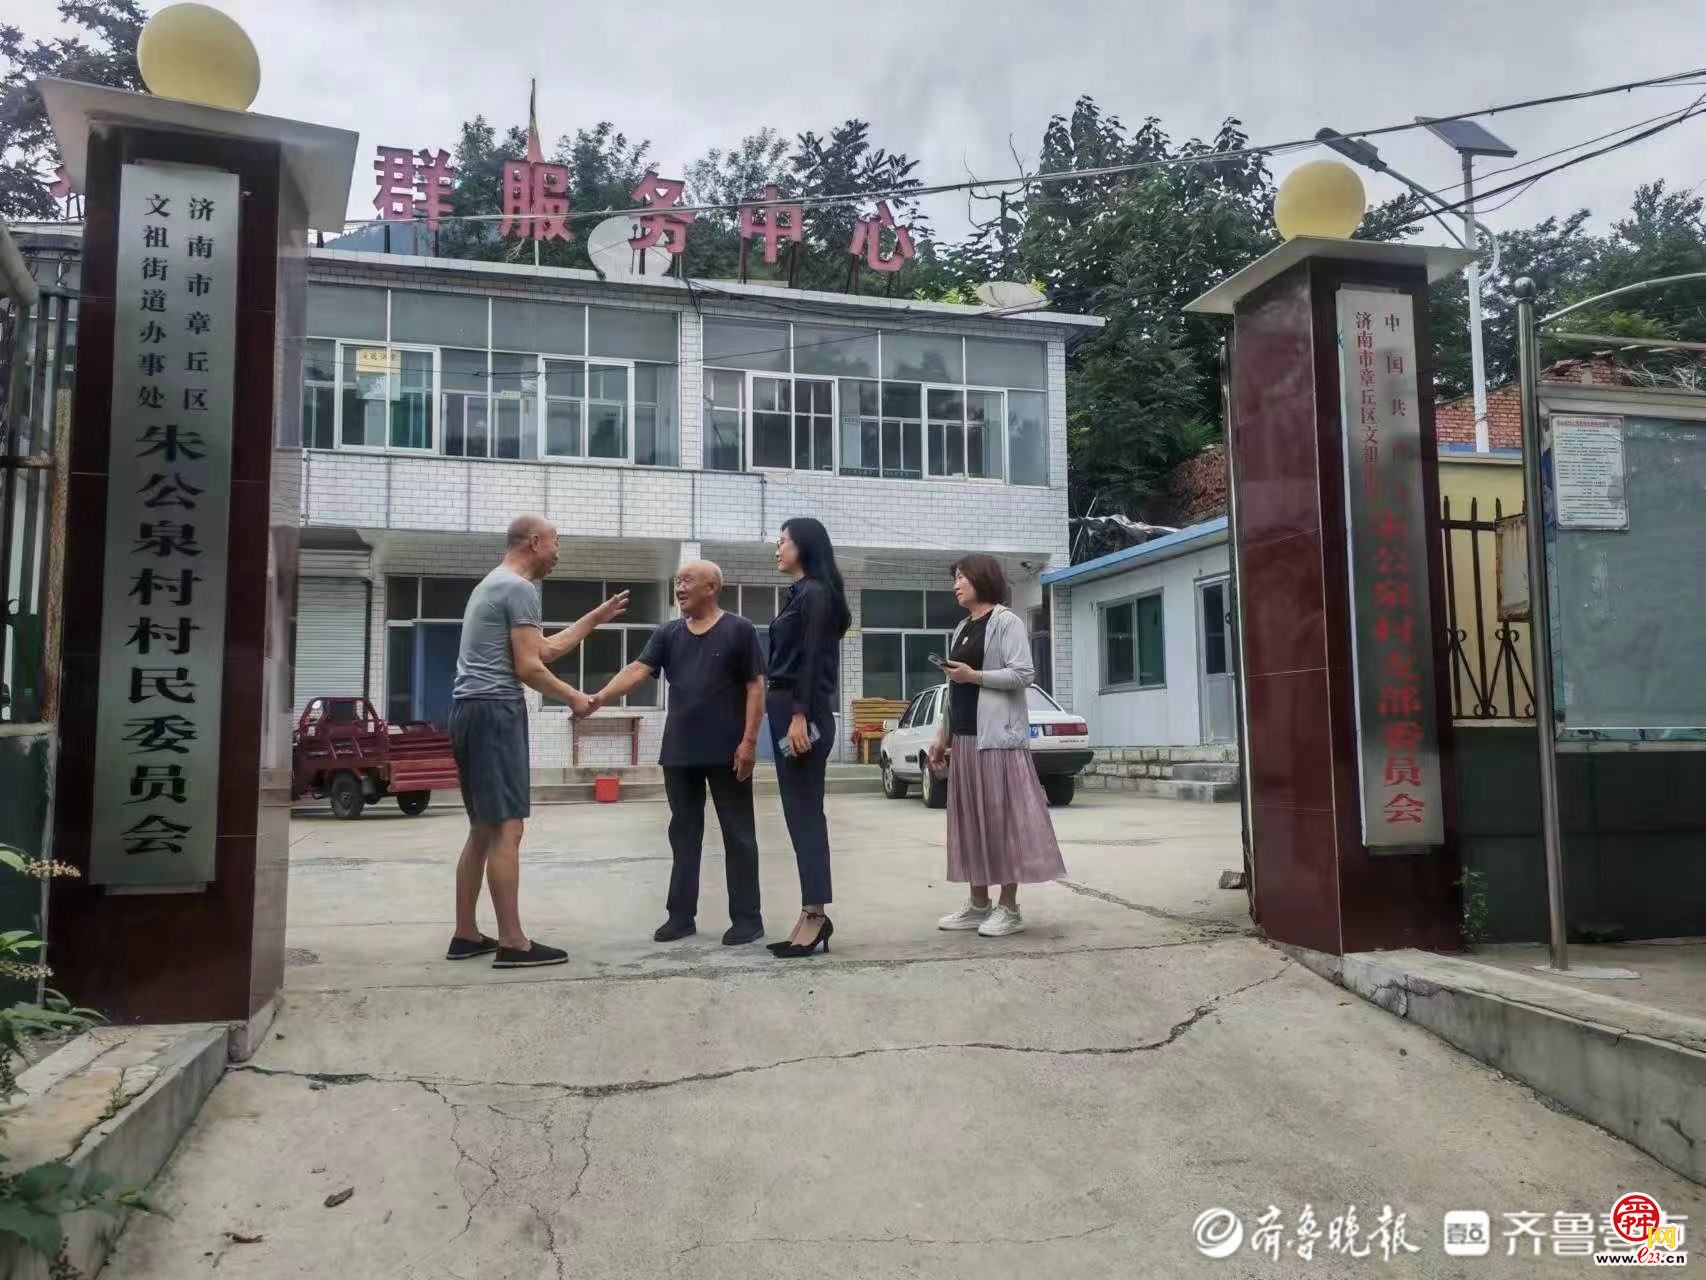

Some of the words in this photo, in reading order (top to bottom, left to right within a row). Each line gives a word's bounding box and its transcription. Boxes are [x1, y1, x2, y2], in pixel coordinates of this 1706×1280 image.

[137, 193, 171, 409] 文祖街道办事处
[184, 198, 215, 411] 济南市章丘区
[1356, 311, 1379, 501] 济南市章丘区文祖
[1384, 313, 1409, 499] 中国共
[121, 425, 207, 855] 朱公泉村村民委员会
